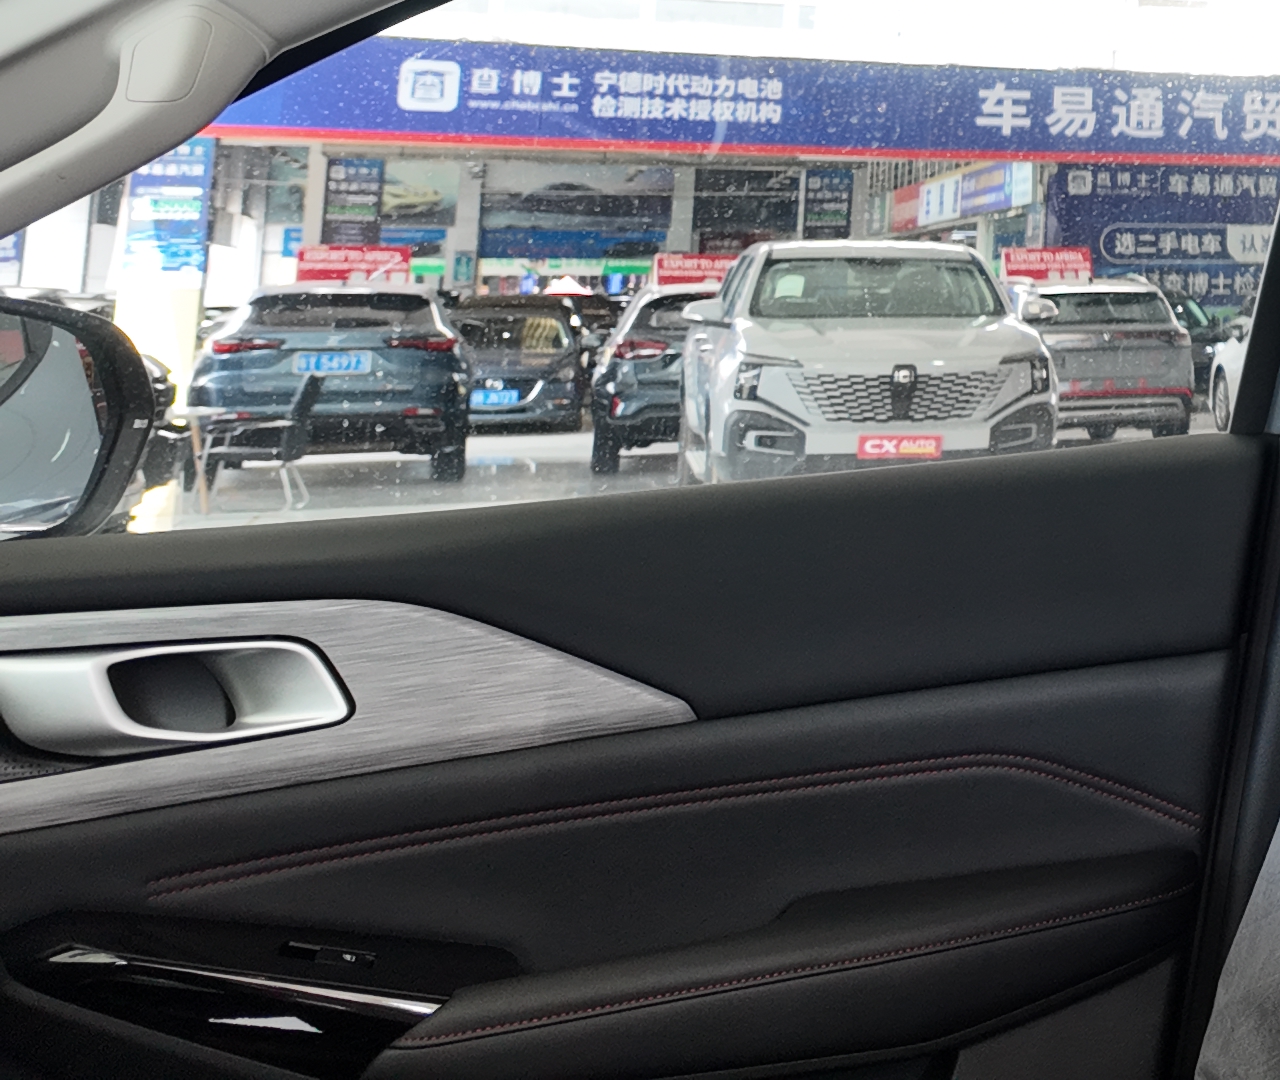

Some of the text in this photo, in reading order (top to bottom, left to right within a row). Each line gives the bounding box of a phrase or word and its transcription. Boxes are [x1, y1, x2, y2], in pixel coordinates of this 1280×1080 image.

[592, 70, 783, 100] 宁德时代动力电池
[591, 95, 782, 124] 检测技术授权机构
[1168, 173, 1278, 198] 车易通汽贸
[1114, 231, 1222, 256] 选二手电车
[864, 439, 897, 453] CX
